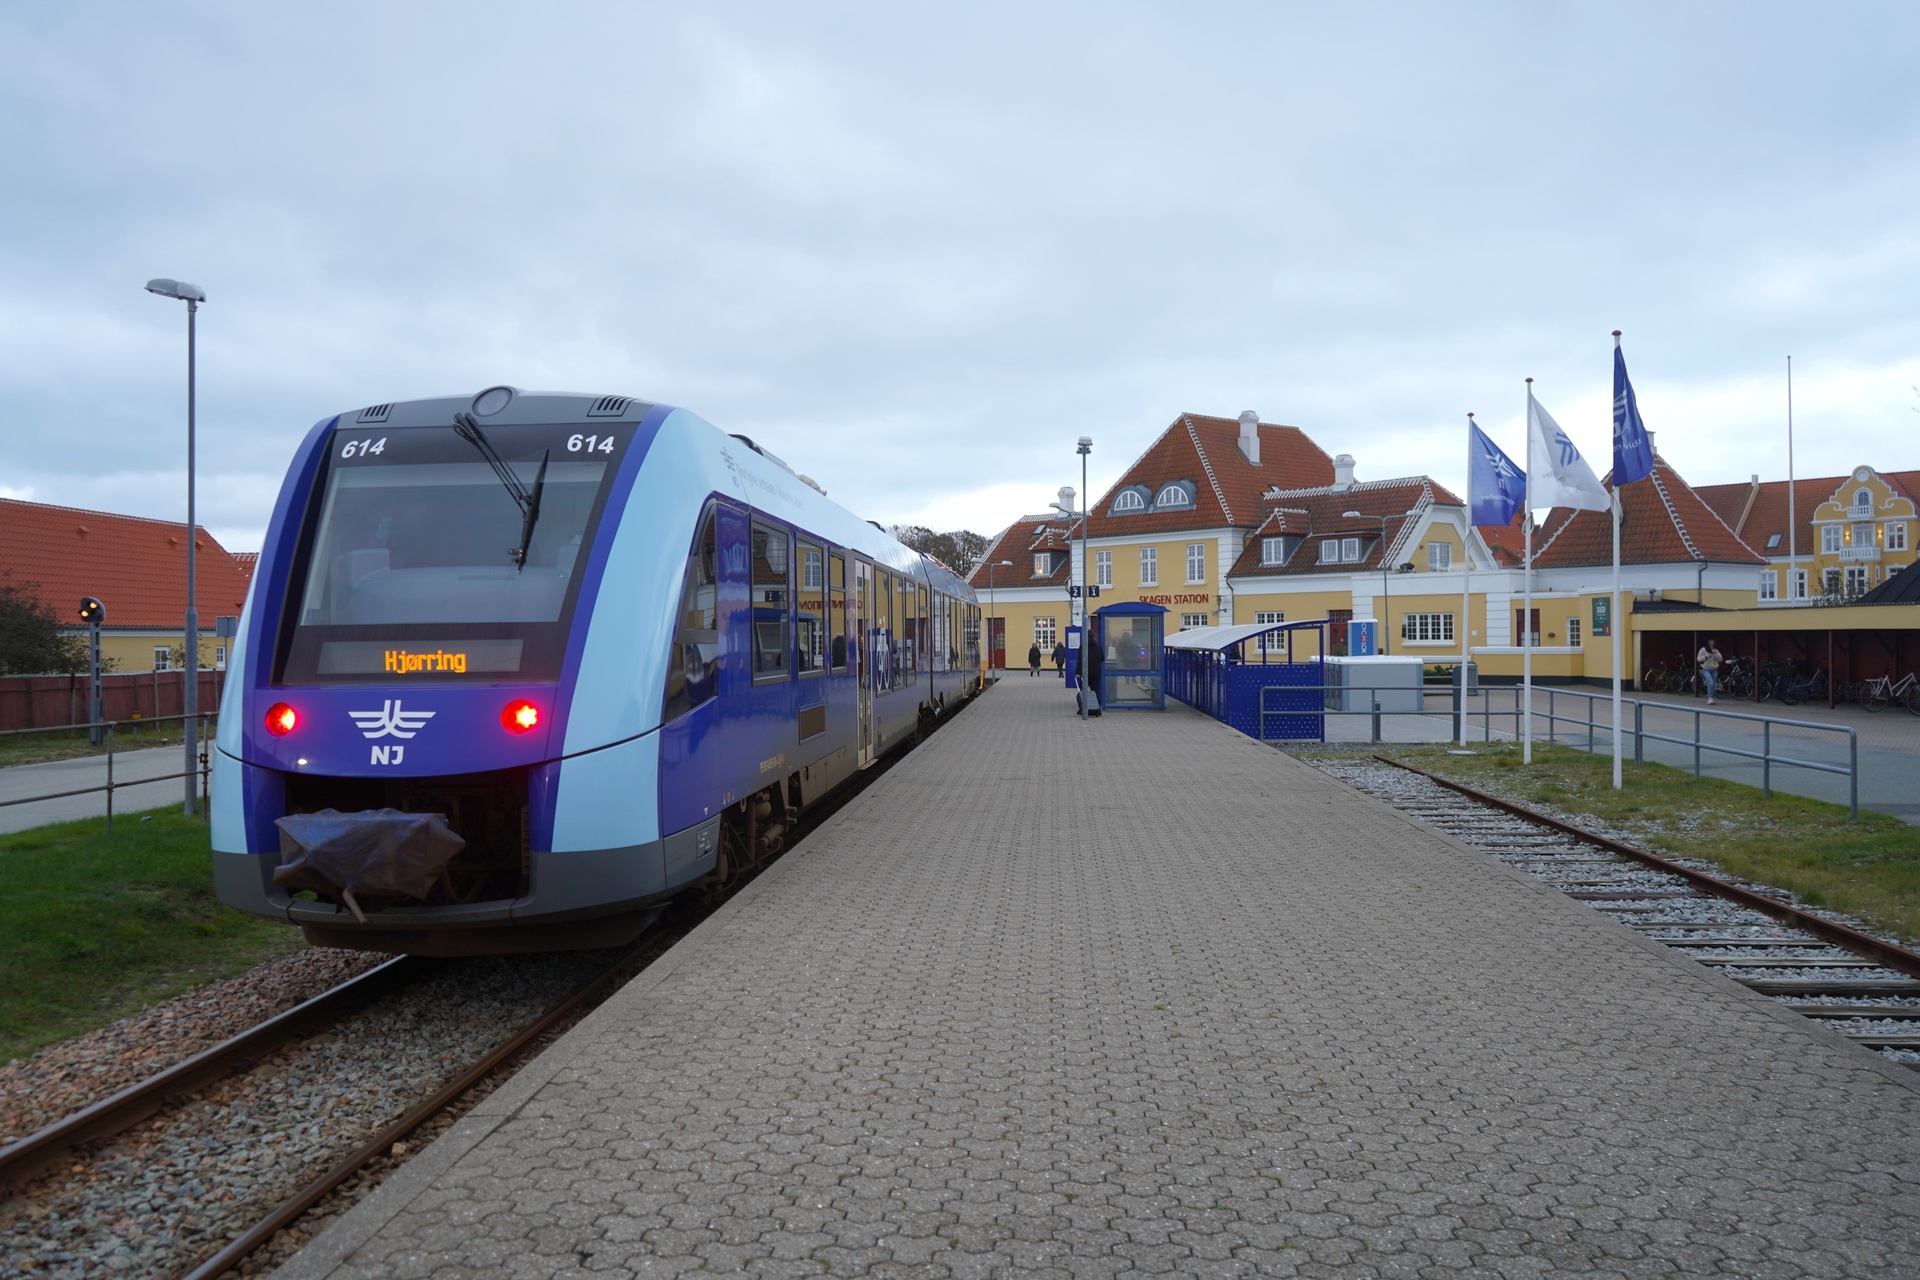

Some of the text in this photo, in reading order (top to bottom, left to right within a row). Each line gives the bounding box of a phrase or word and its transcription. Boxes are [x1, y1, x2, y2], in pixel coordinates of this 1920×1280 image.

[341, 437, 387, 459] 614
[566, 434, 615, 454] 614
[1139, 593, 1209, 605] SKAGEN STATION
[385, 649, 467, 674] Hjørring
[370, 745, 404, 765] NJ
